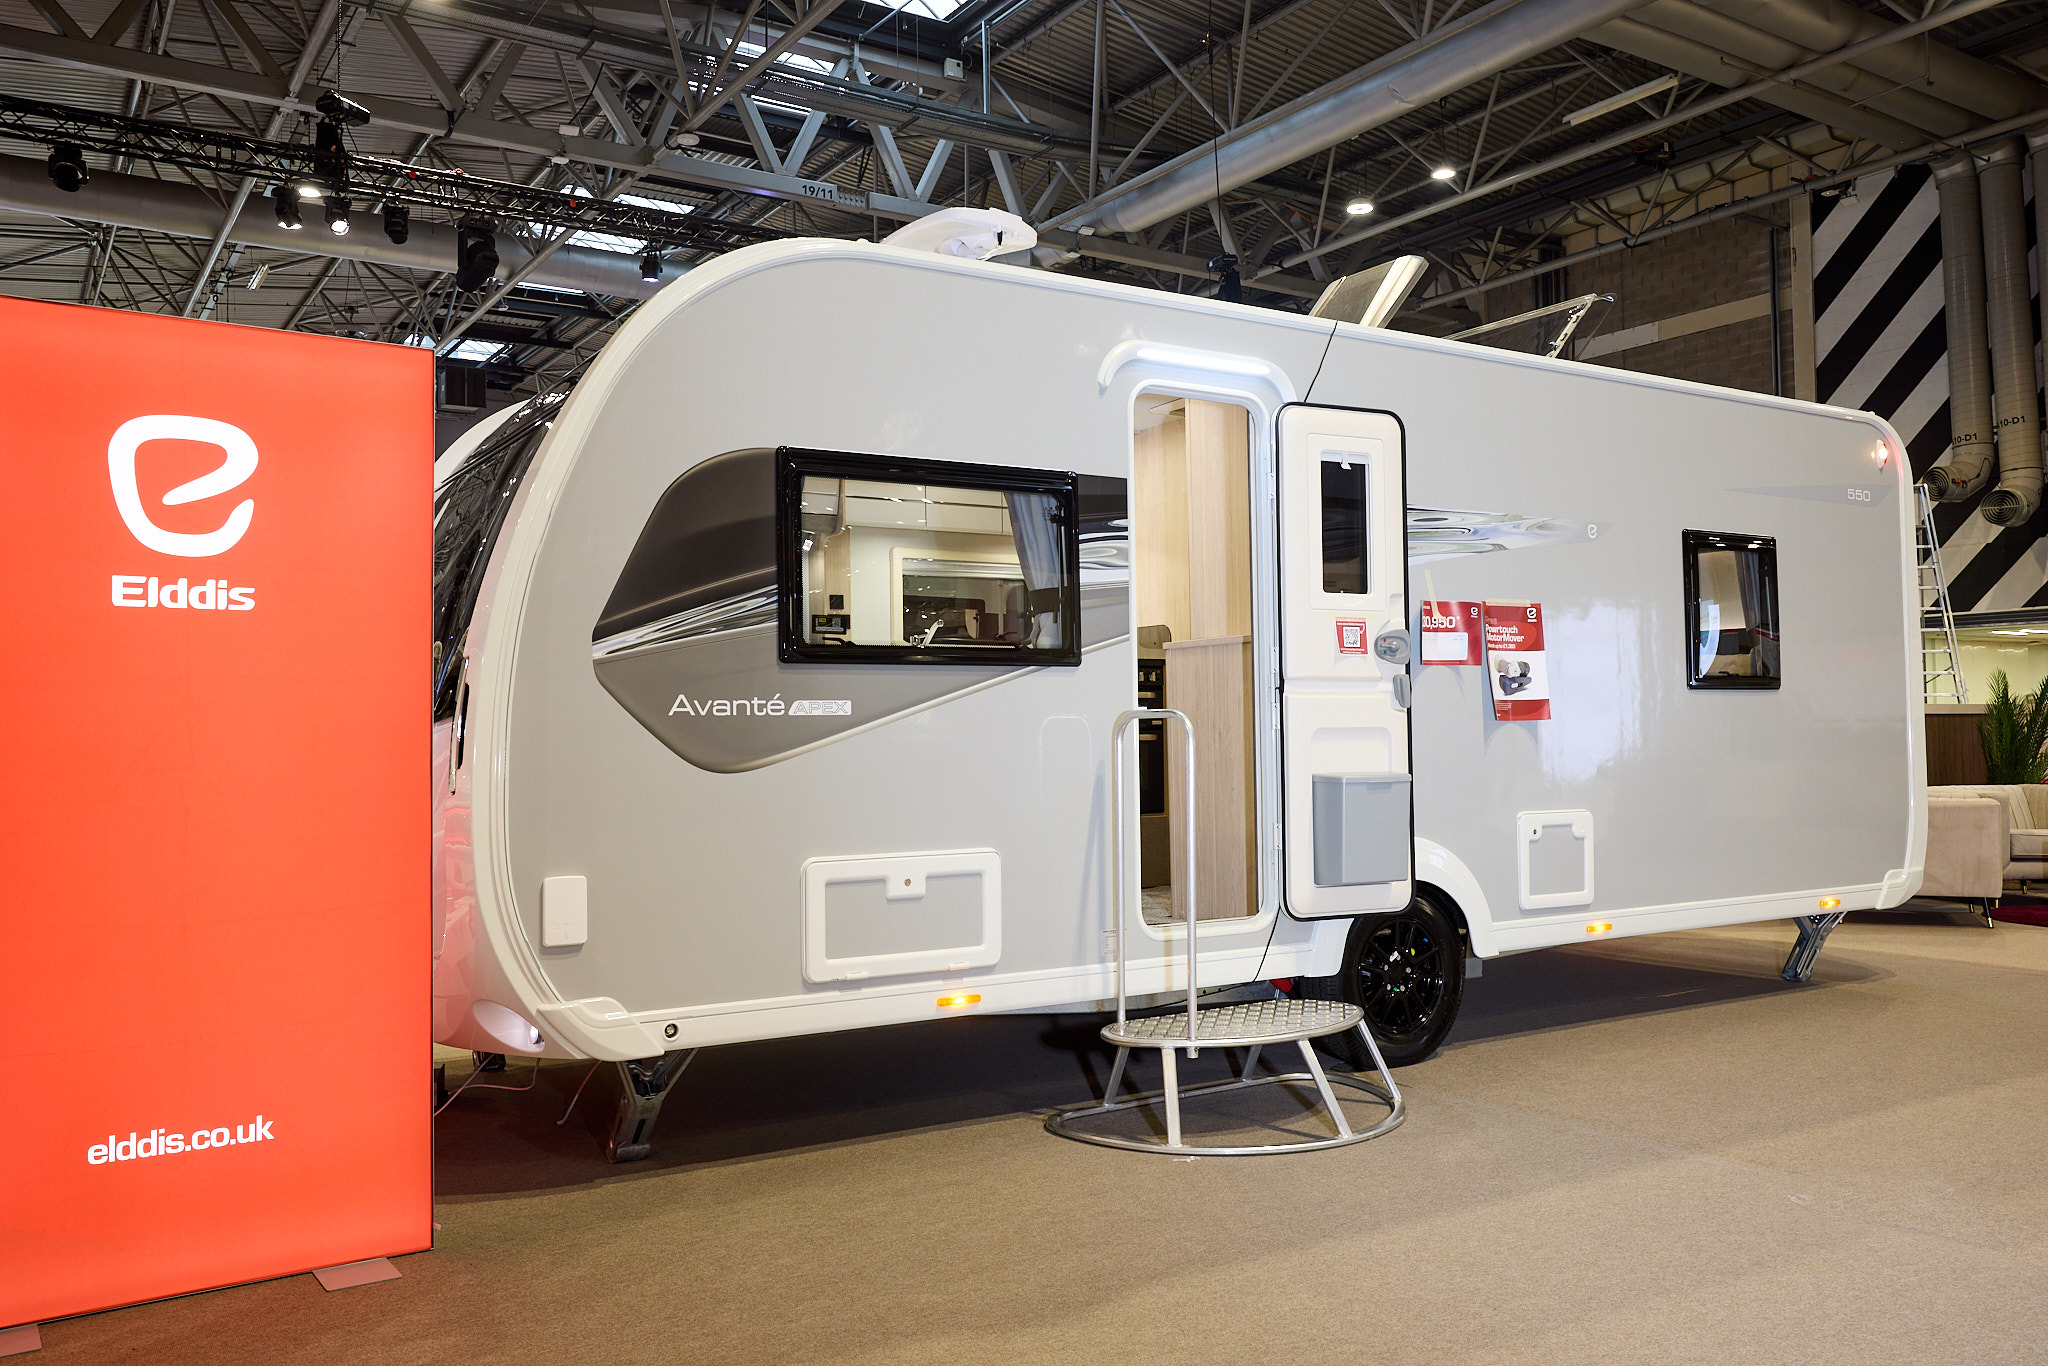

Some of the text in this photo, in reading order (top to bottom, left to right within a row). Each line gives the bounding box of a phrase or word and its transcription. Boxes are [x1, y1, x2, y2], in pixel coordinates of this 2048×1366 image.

[802, 185, 833, 199] 19/11
[1847, 488, 1871, 502] 550
[111, 574, 256, 611] Elddis
[1486, 632, 1525, 642] MotorMover
[668, 693, 848, 716] Avanté APEX
[87, 1115, 275, 1165] elddis.co.uk
